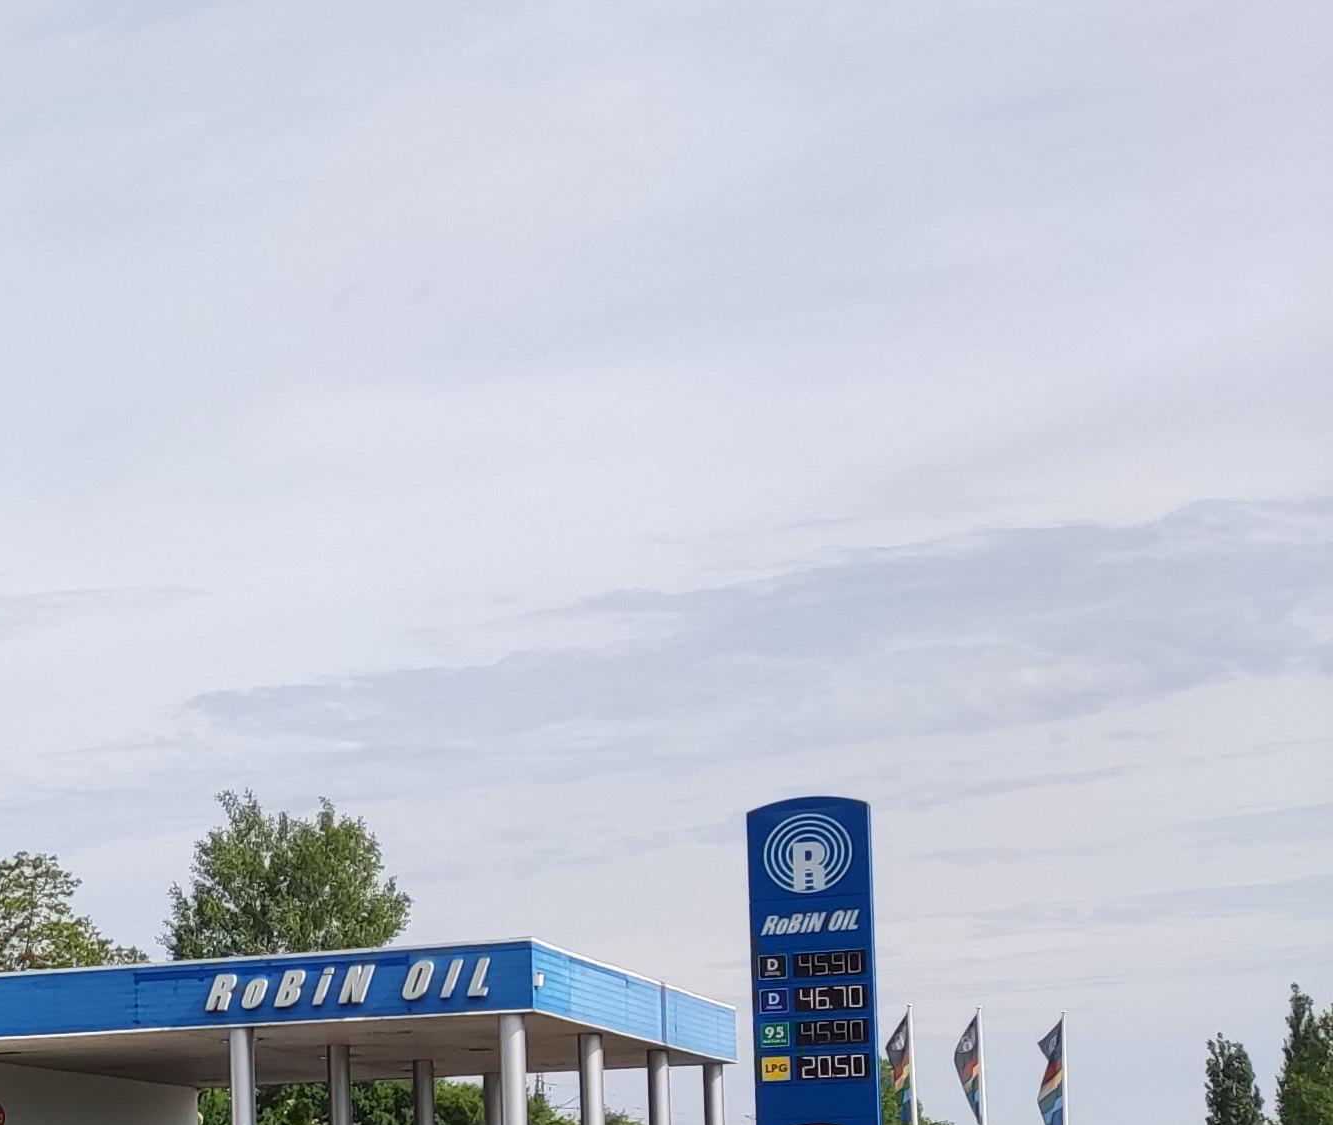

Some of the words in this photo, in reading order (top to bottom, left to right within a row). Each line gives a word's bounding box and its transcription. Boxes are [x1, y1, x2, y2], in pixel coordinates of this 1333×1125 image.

[828, 909, 861, 932] OIL
[767, 958, 779, 971] D
[401, 957, 491, 1001] OIL
[768, 992, 781, 1005] D
[799, 985, 863, 1010] 46.70
[764, 1026, 785, 1039] 95
[765, 1063, 789, 1074] LPG
